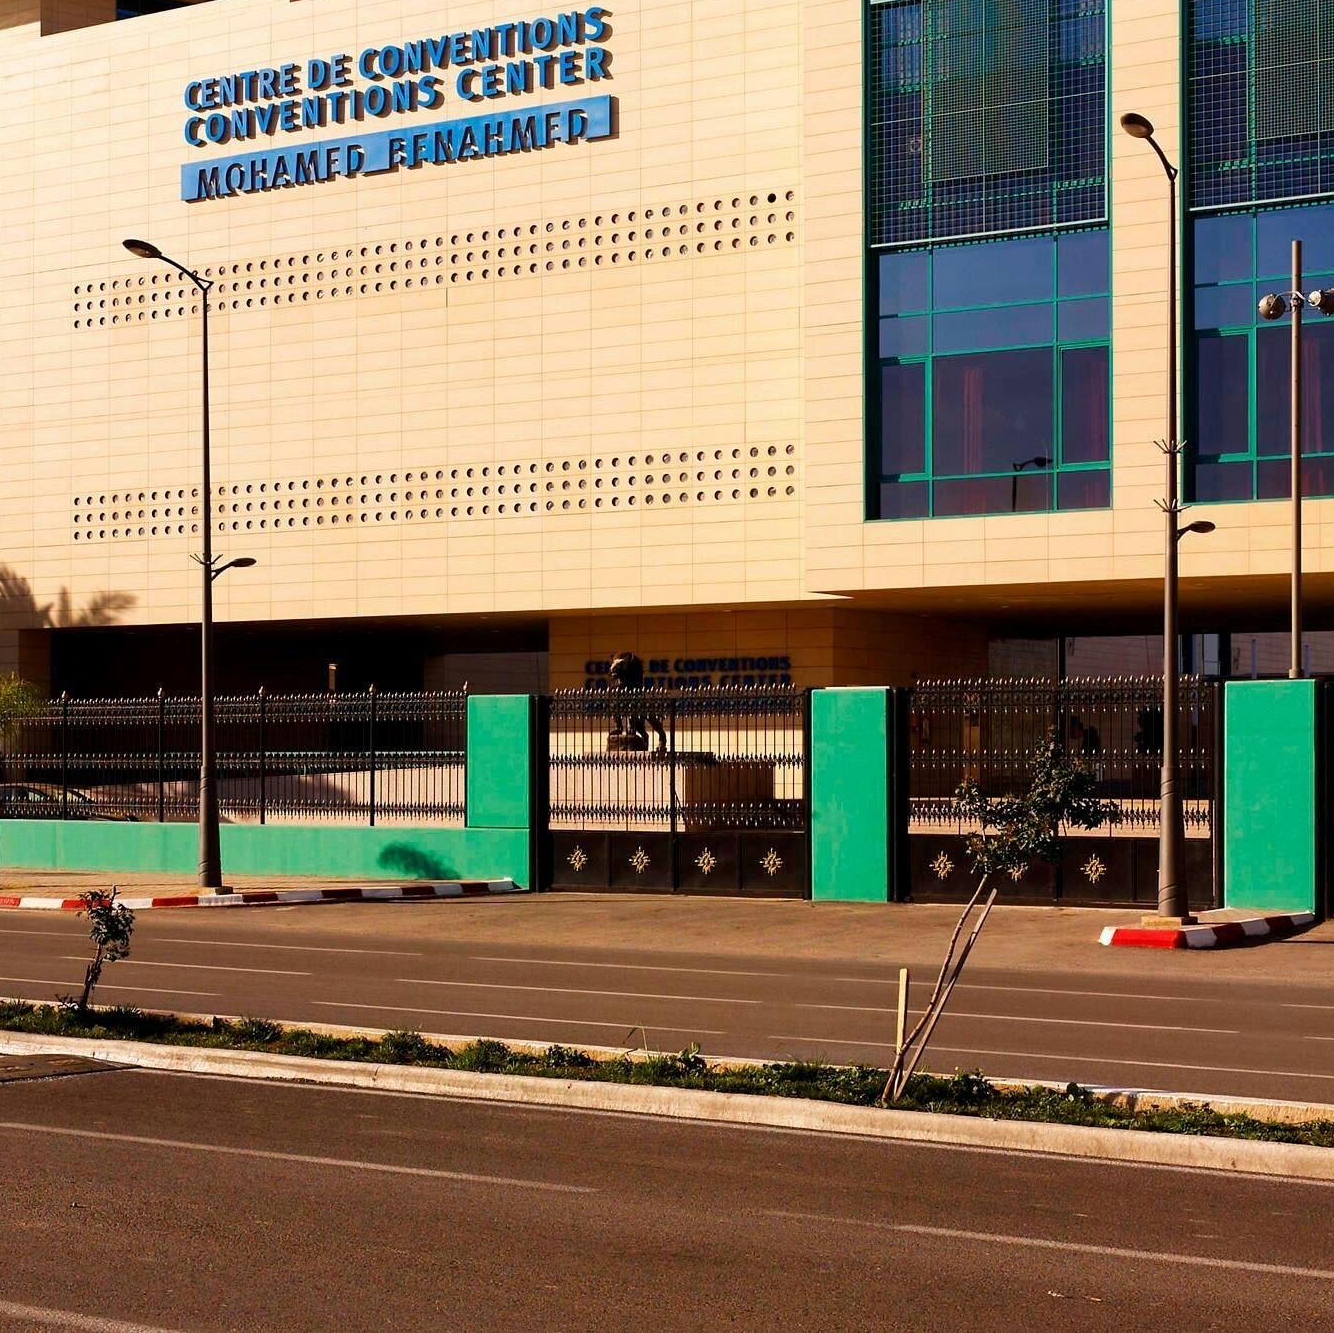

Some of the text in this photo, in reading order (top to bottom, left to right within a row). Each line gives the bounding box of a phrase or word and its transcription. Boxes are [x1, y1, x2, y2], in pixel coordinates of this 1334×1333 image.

[184, 6, 608, 112] CENTRE DE CONVENTIONS
[184, 45, 609, 146] CONVENTIONS CENTER
[196, 107, 589, 201] MOHAMED BENAHMED
